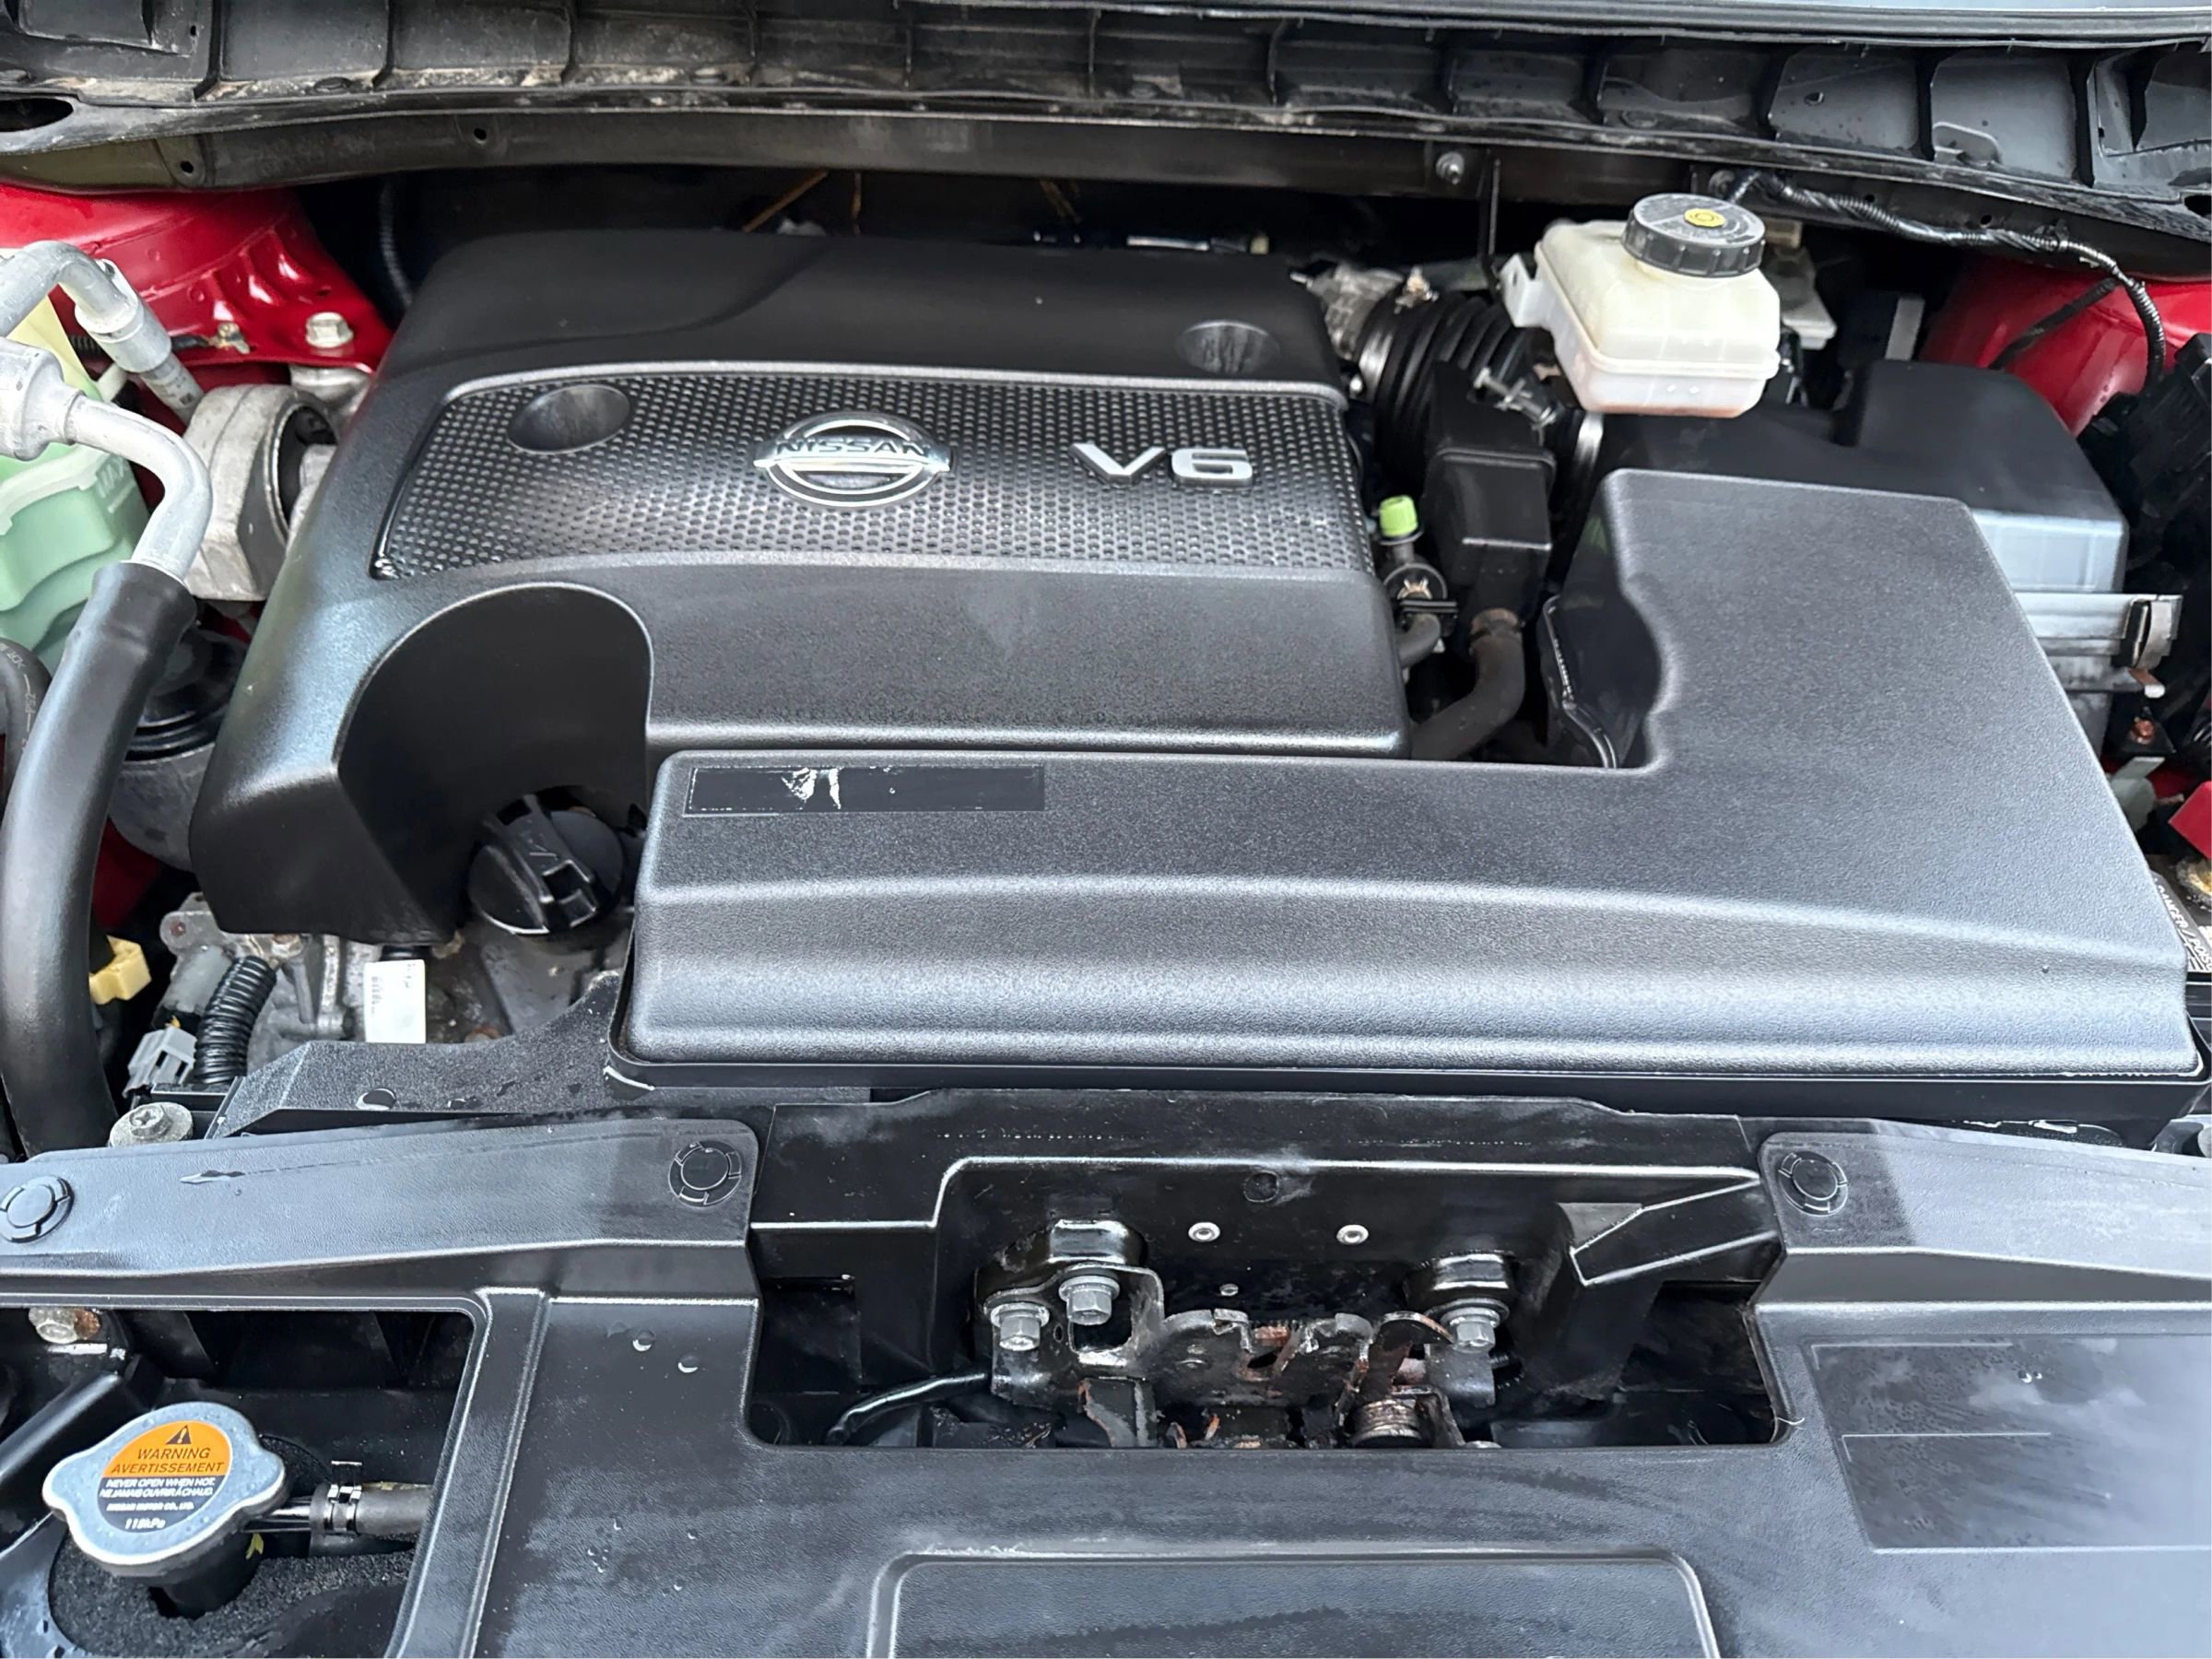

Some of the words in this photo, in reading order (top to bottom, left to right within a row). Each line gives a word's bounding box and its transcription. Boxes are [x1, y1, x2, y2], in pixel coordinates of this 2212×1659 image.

[776, 437, 931, 458] NISSAN
[1068, 442, 1253, 488] V6
[137, 1447, 211, 1460] WARNING
[111, 1462, 225, 1474] AVERTISSEMENT
[106, 1478, 137, 1488] NEVER
[137, 1478, 165, 1488] OPEN
[166, 1477, 194, 1487] WHEN
